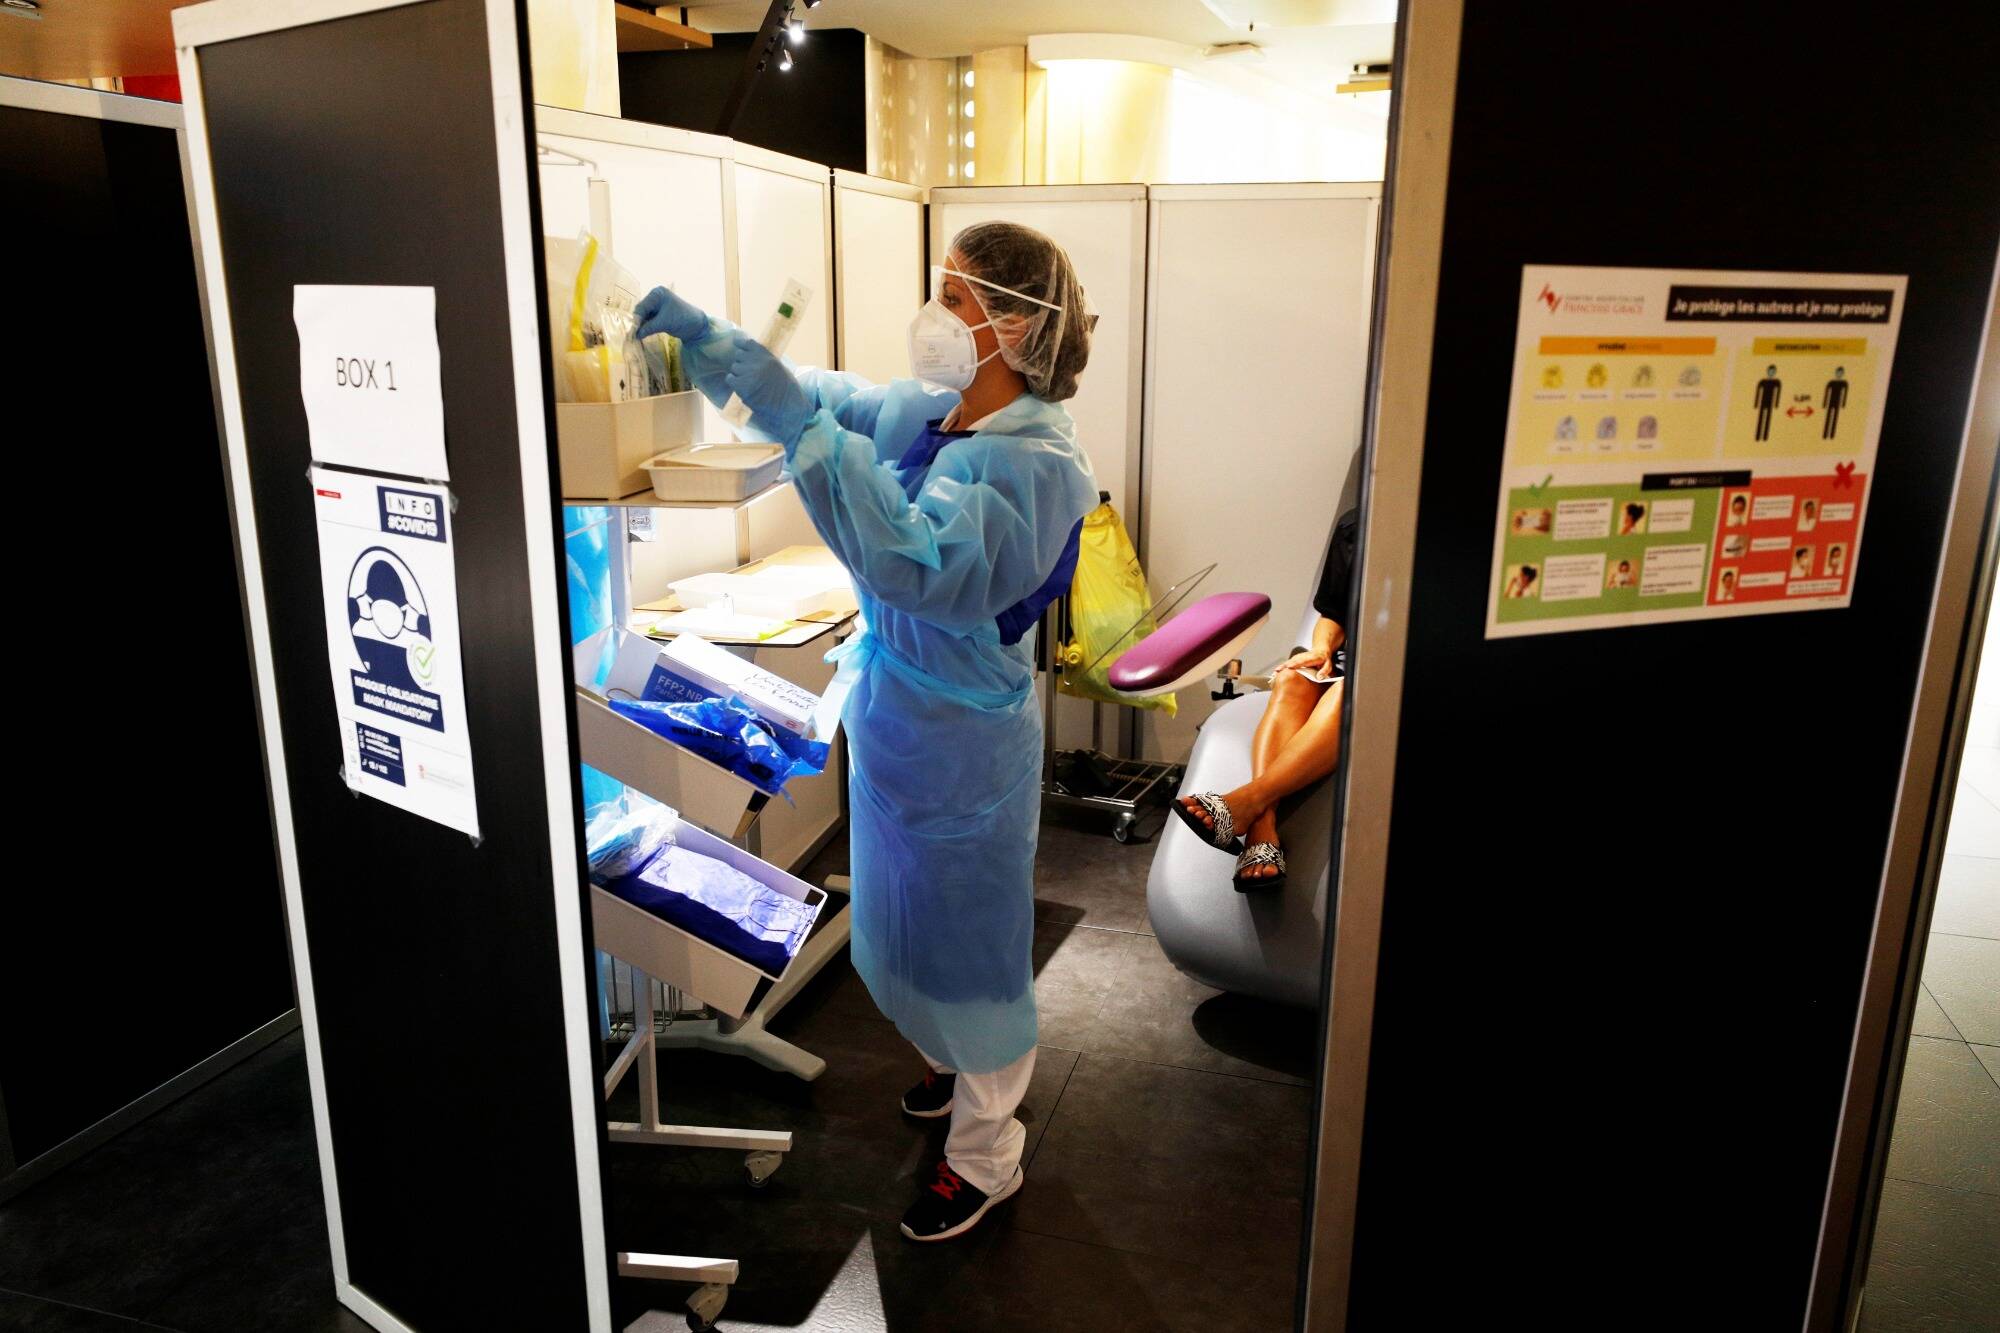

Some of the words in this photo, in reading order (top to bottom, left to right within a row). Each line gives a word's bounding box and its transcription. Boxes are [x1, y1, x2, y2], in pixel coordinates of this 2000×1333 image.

[1672, 298, 1688, 314] Je
[1688, 299, 1736, 317] protège
[1737, 299, 1755, 314] les
[1757, 301, 1794, 315] autres
[1795, 301, 1808, 315] et
[1807, 301, 1821, 318] je
[1822, 303, 1840, 316] me
[1840, 301, 1886, 319] protège
[336, 357, 378, 390] BOX
[385, 361, 397, 391] 1
[388, 495, 432, 515] INFO
[387, 514, 438, 537] #COVID19
[657, 674, 686, 696] FFP2
